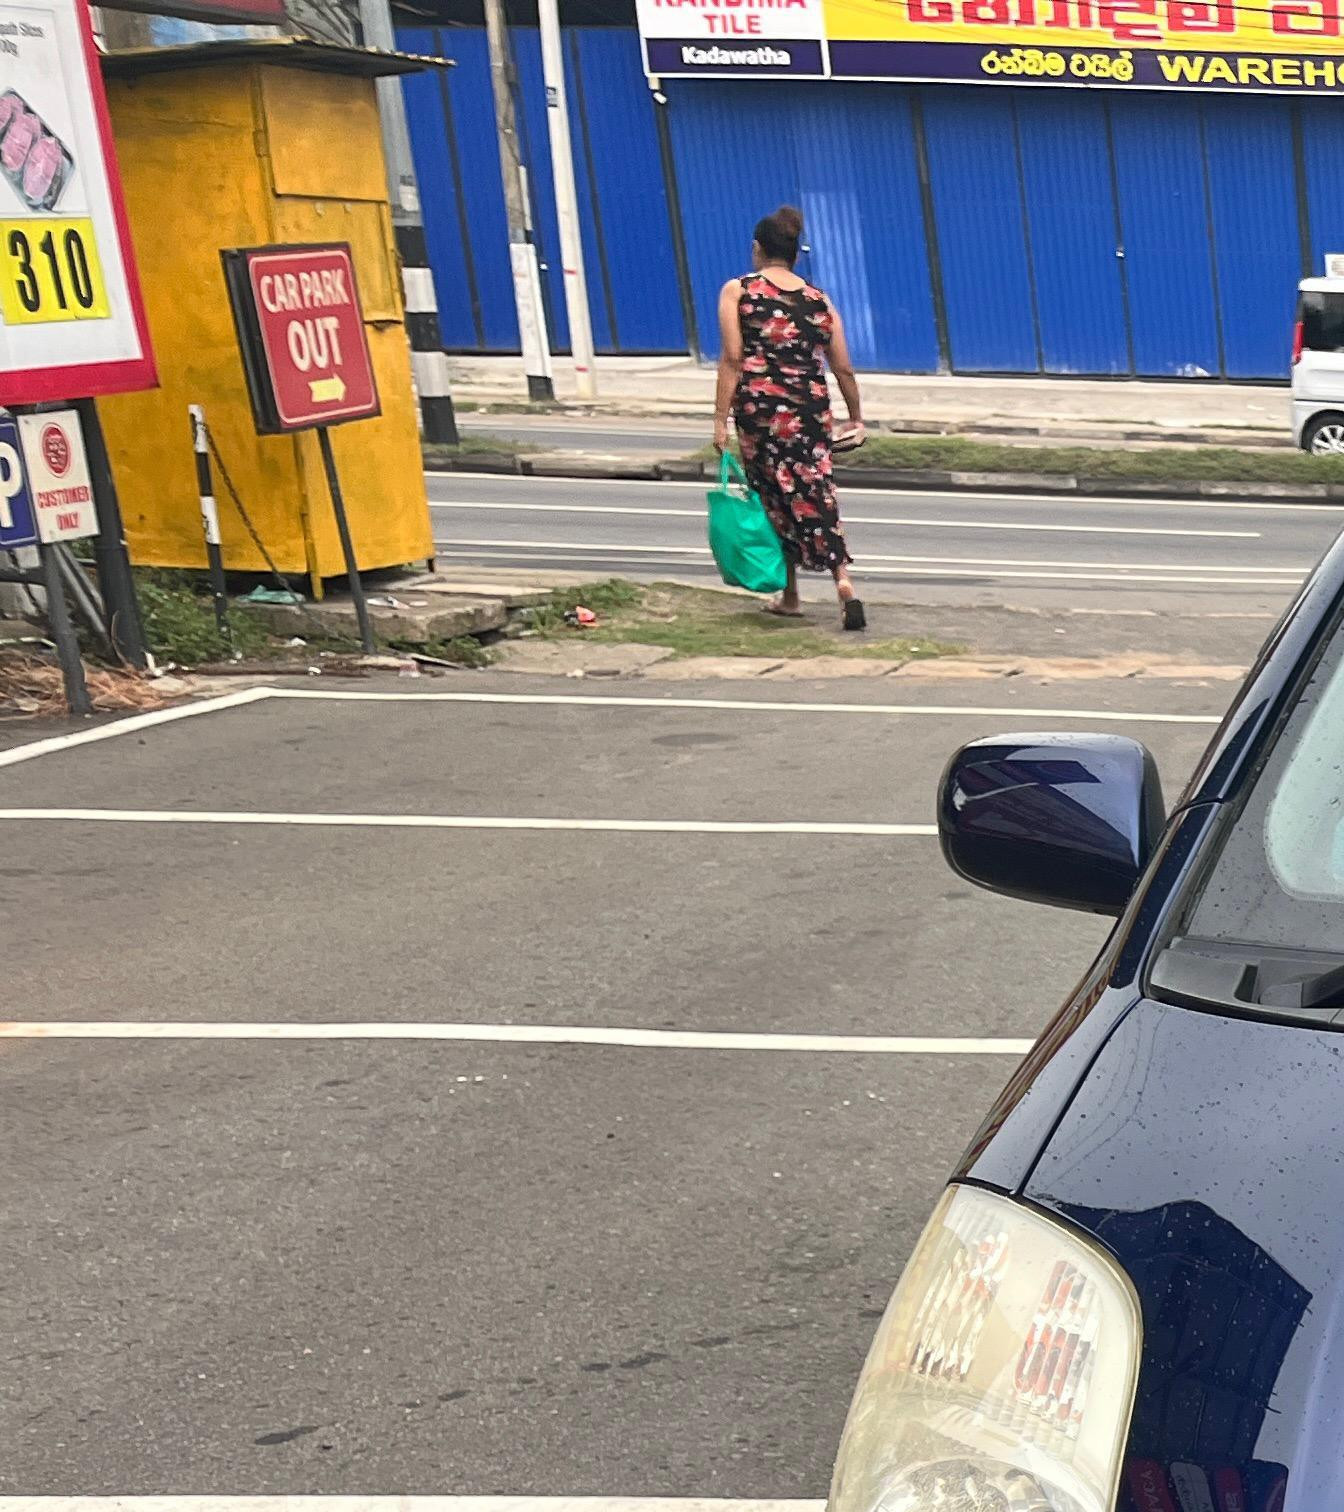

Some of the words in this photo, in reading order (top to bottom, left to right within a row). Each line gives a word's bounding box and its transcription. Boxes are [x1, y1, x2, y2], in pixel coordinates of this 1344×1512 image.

[704, 15, 762, 34] TILE
[682, 46, 791, 66] Kadawatha
[8, 228, 94, 313] 310
[260, 273, 303, 314] CAR
[299, 268, 351, 310] PARK
[287, 316, 344, 373] OUT
[38, 485, 90, 509] CUSTOMER
[56, 511, 80, 531] ONLY
